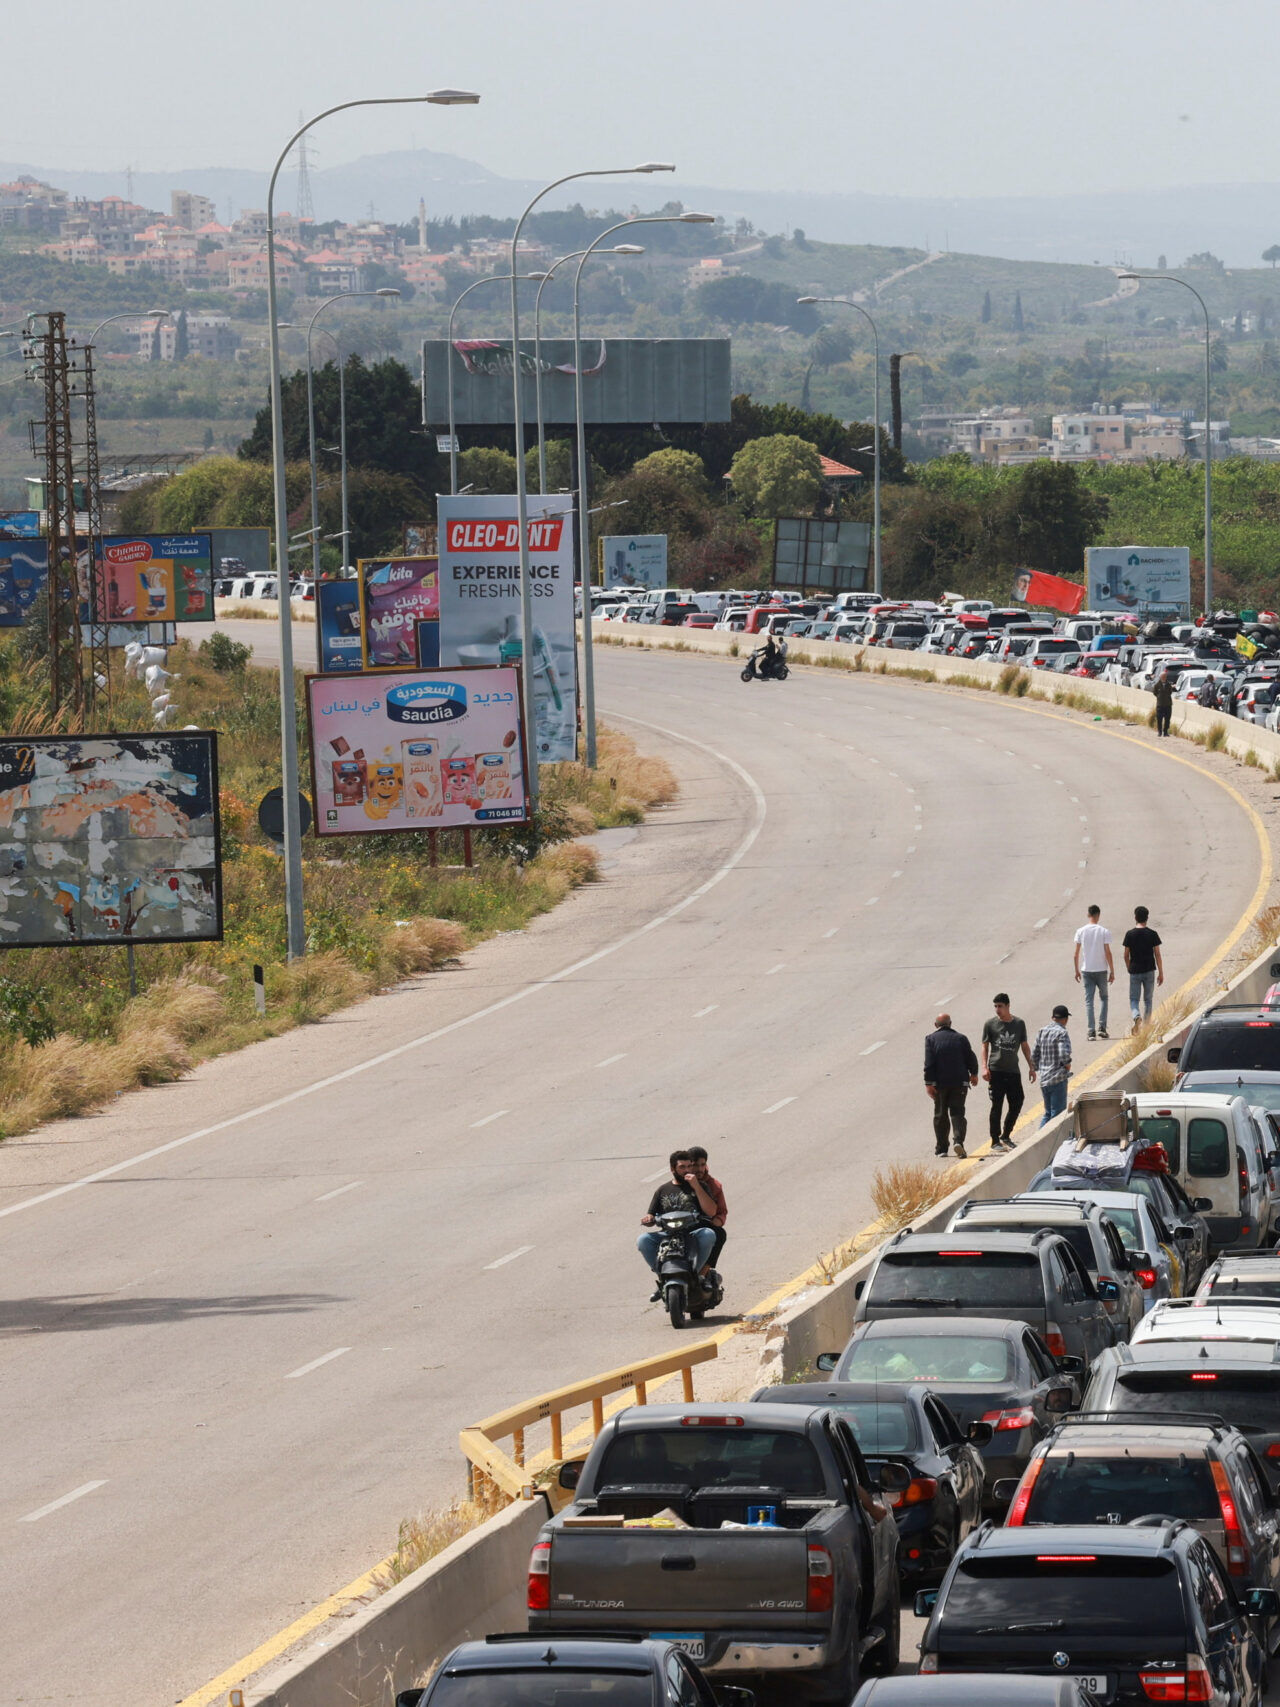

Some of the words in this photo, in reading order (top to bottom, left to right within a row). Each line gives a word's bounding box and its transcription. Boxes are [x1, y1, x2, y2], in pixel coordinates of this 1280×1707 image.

[451, 523, 555, 548] CLEO-DNT
[390, 566, 413, 581] kita
[458, 583, 554, 598] FRESHNSS
[396, 685, 455, 700] السعودية
[472, 690, 514, 707] جديد
[321, 701, 358, 716] لبنان
[361, 697, 381, 717] في
[402, 706, 454, 721] saudia
[576, 1600, 625, 1608] TUNDRA
[777, 1600, 804, 1608] 4WD
